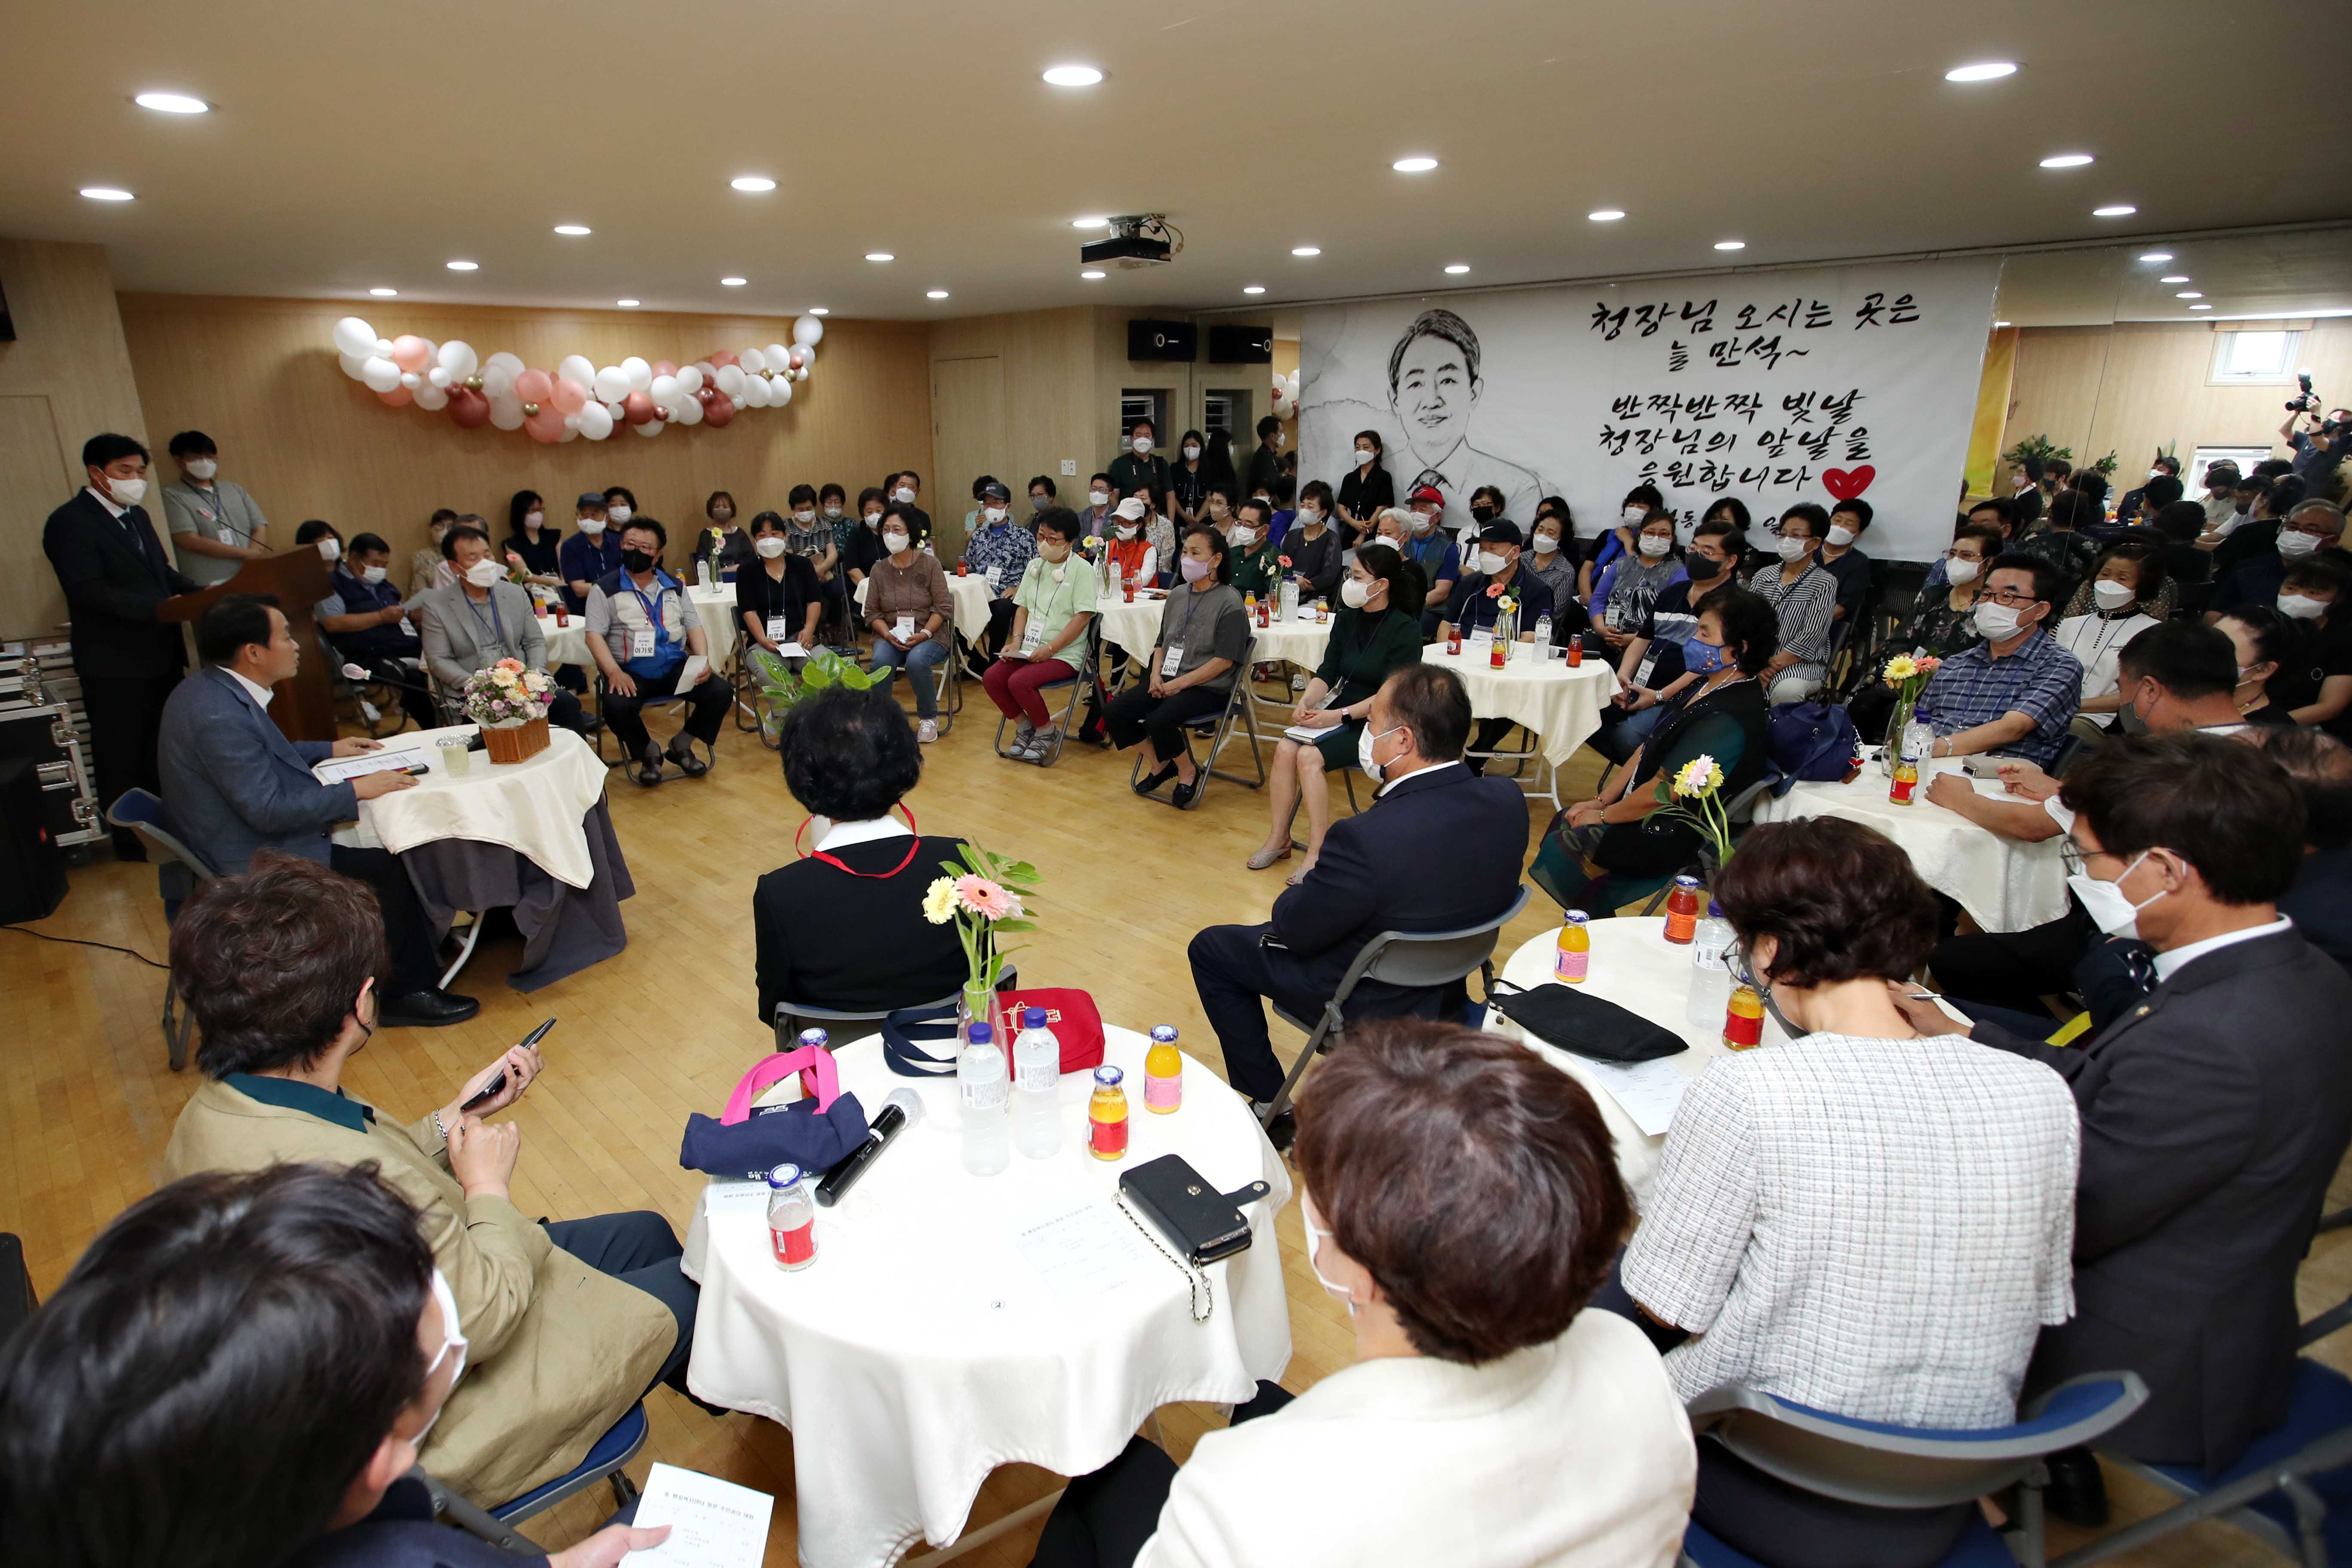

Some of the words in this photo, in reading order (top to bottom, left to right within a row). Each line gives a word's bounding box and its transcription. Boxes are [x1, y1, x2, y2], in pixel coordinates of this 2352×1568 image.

[1591, 299, 1718, 341] 청장님
[1735, 298, 1832, 330] 오시는
[1855, 292, 1920, 330] 곳은
[1669, 340, 1689, 371] 늘
[1612, 392, 1763, 425] 반짝반짝
[1782, 389, 1867, 425] 빛날
[1599, 423, 1737, 456] 청장님의
[1757, 426, 1871, 461] 앞날을
[1638, 459, 1814, 493] 응원합니다
[1026, 635, 1039, 643] 김경숙
